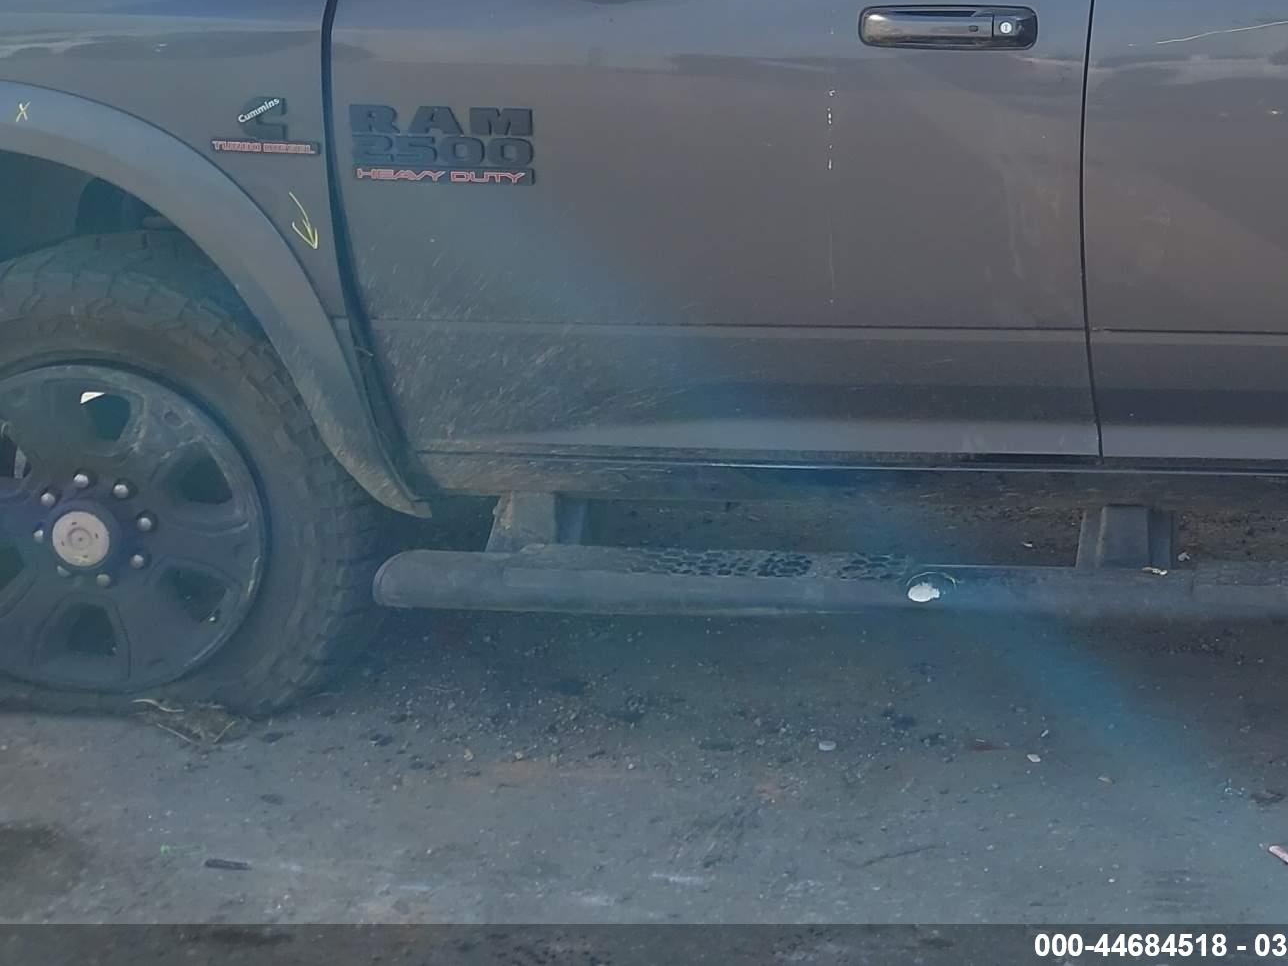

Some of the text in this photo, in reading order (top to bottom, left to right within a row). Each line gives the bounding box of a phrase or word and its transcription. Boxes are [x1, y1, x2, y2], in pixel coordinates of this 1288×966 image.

[237, 98, 280, 123] Cummins
[349, 103, 533, 136] RAM
[351, 135, 535, 166] 2500
[356, 168, 526, 184] HEAVY DUTY
